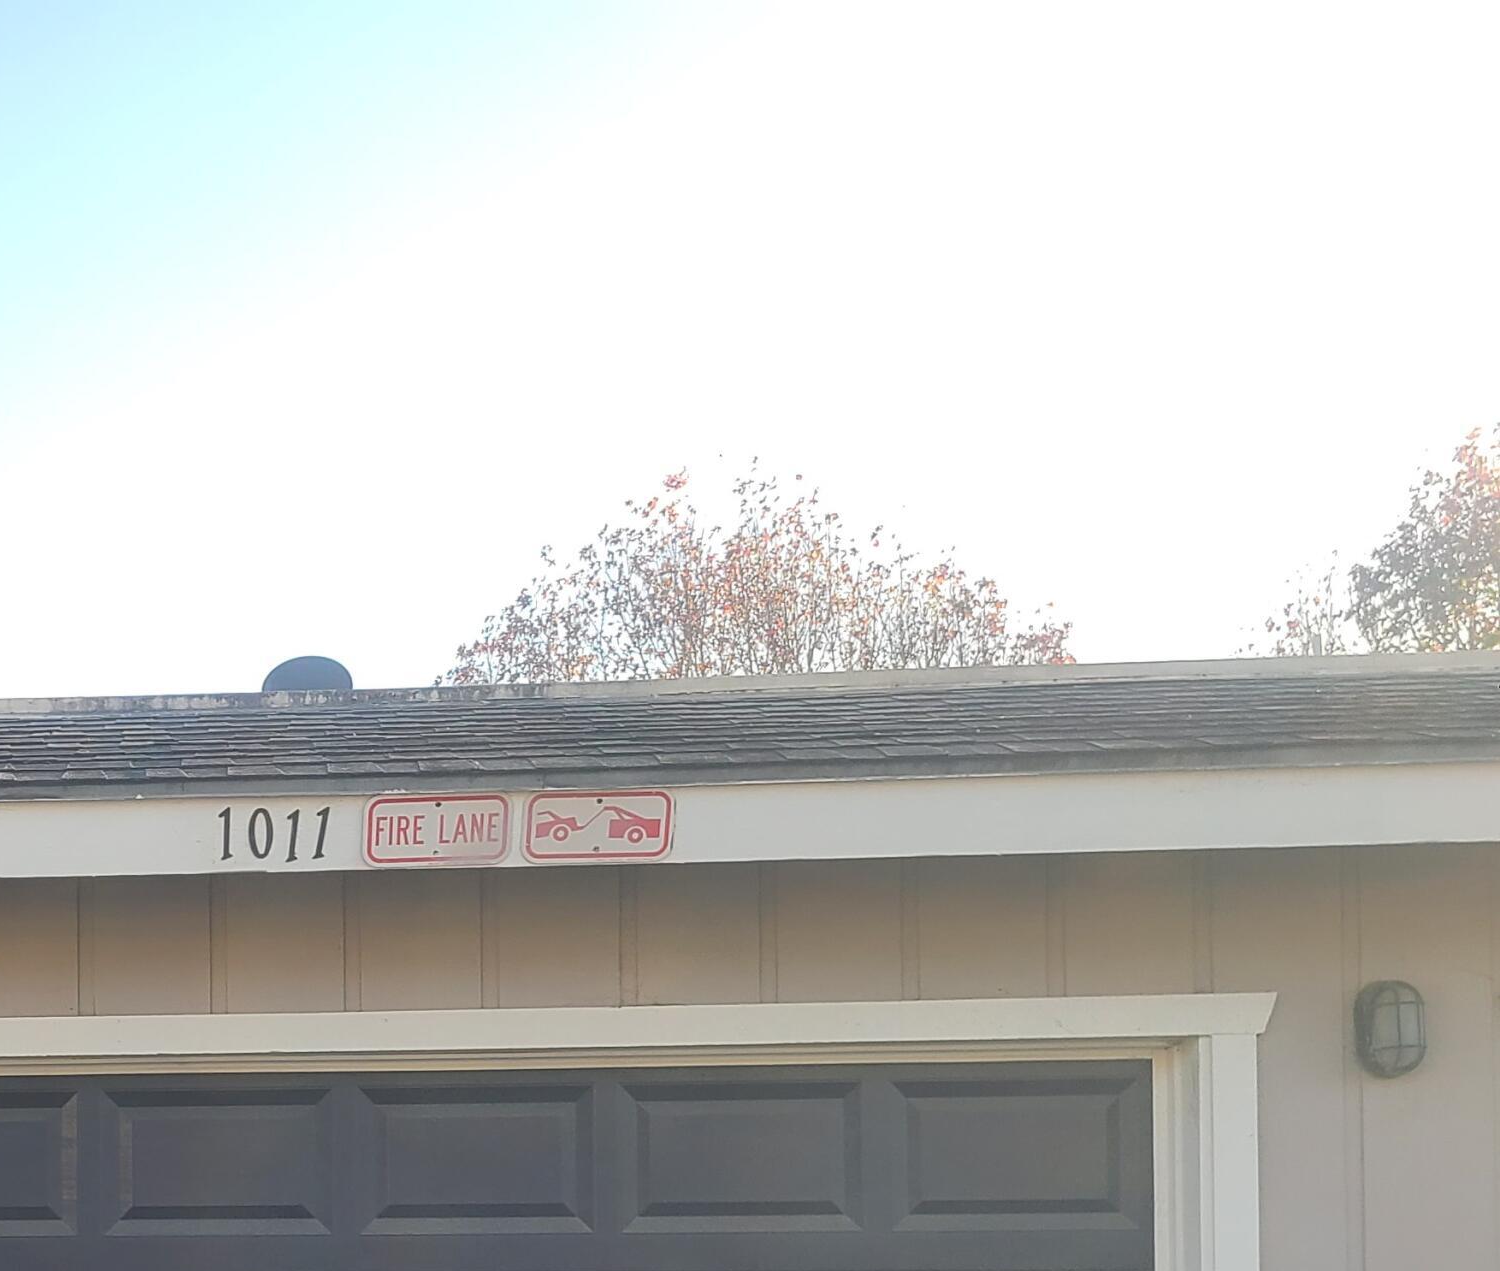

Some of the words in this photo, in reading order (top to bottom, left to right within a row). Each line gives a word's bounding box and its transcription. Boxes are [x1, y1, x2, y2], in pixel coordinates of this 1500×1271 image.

[218, 806, 331, 862] 1011
[375, 816, 425, 846] FIRE
[438, 812, 499, 844] LANE
